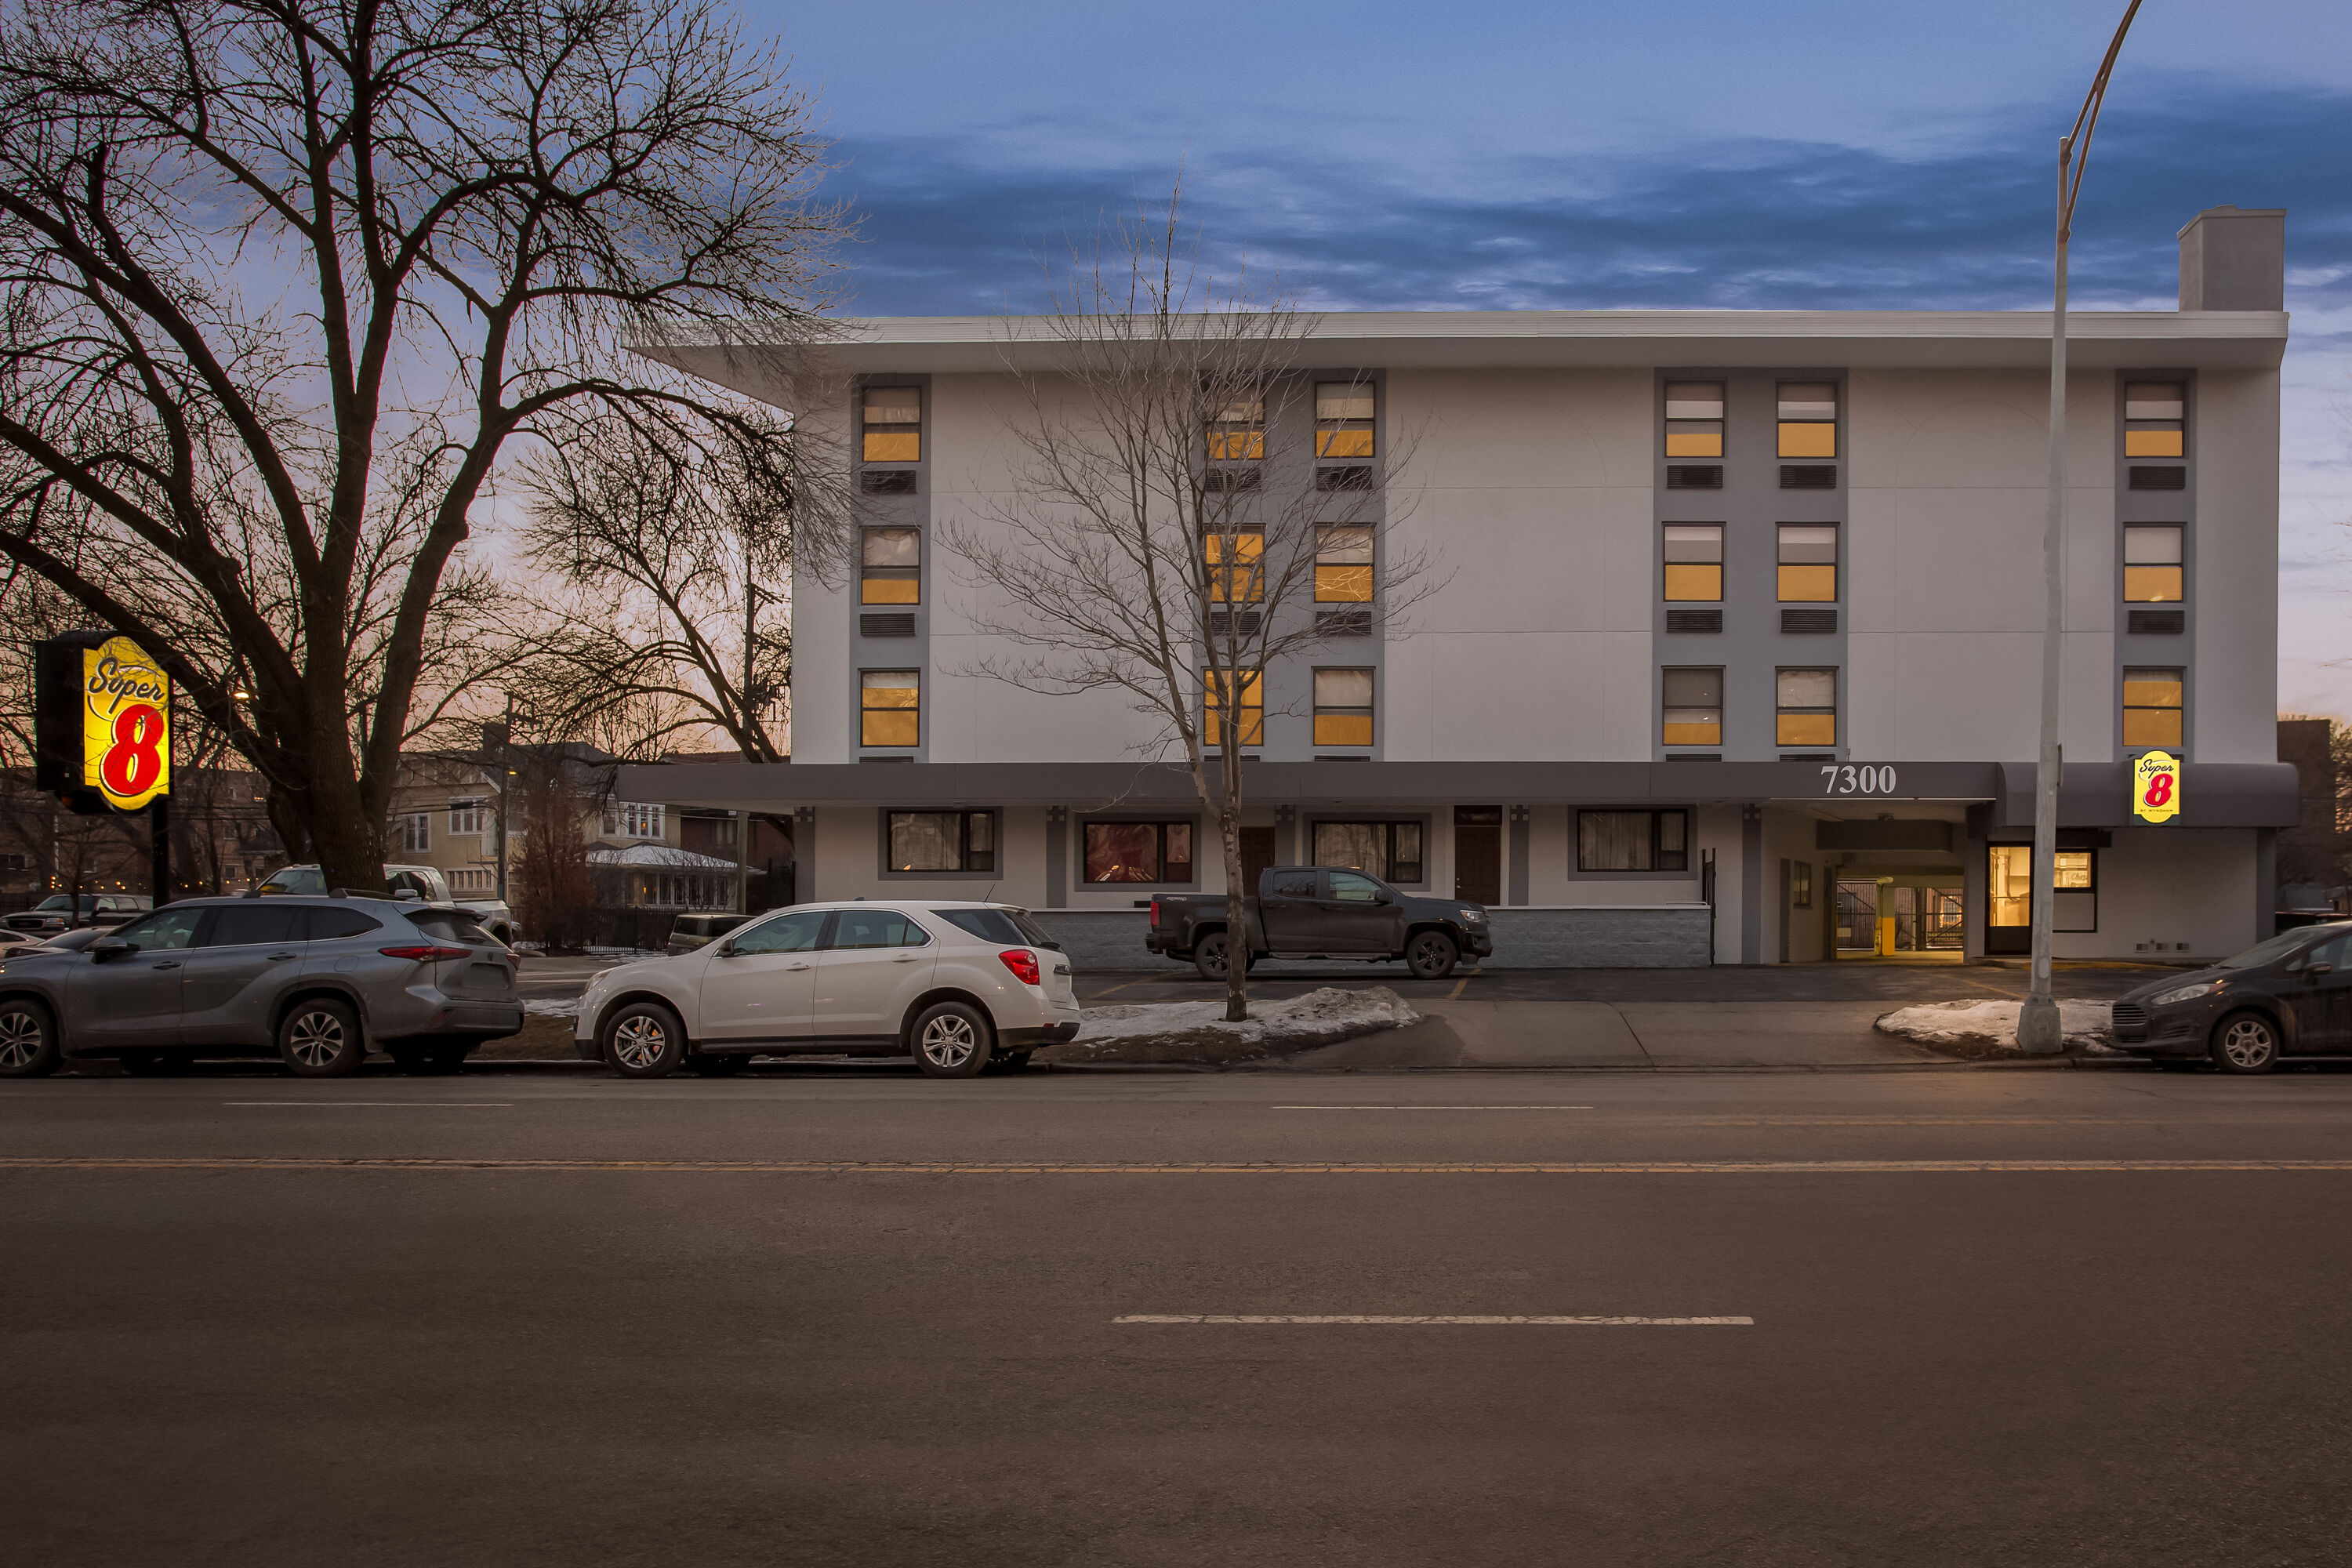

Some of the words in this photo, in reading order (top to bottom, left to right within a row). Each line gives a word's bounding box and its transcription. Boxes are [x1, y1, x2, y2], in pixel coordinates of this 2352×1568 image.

[89, 657, 165, 714] Super
[100, 704, 164, 797] 8
[1820, 765, 1896, 793] 7300
[2139, 759, 2174, 779] Super
[2143, 773, 2173, 807] 8
